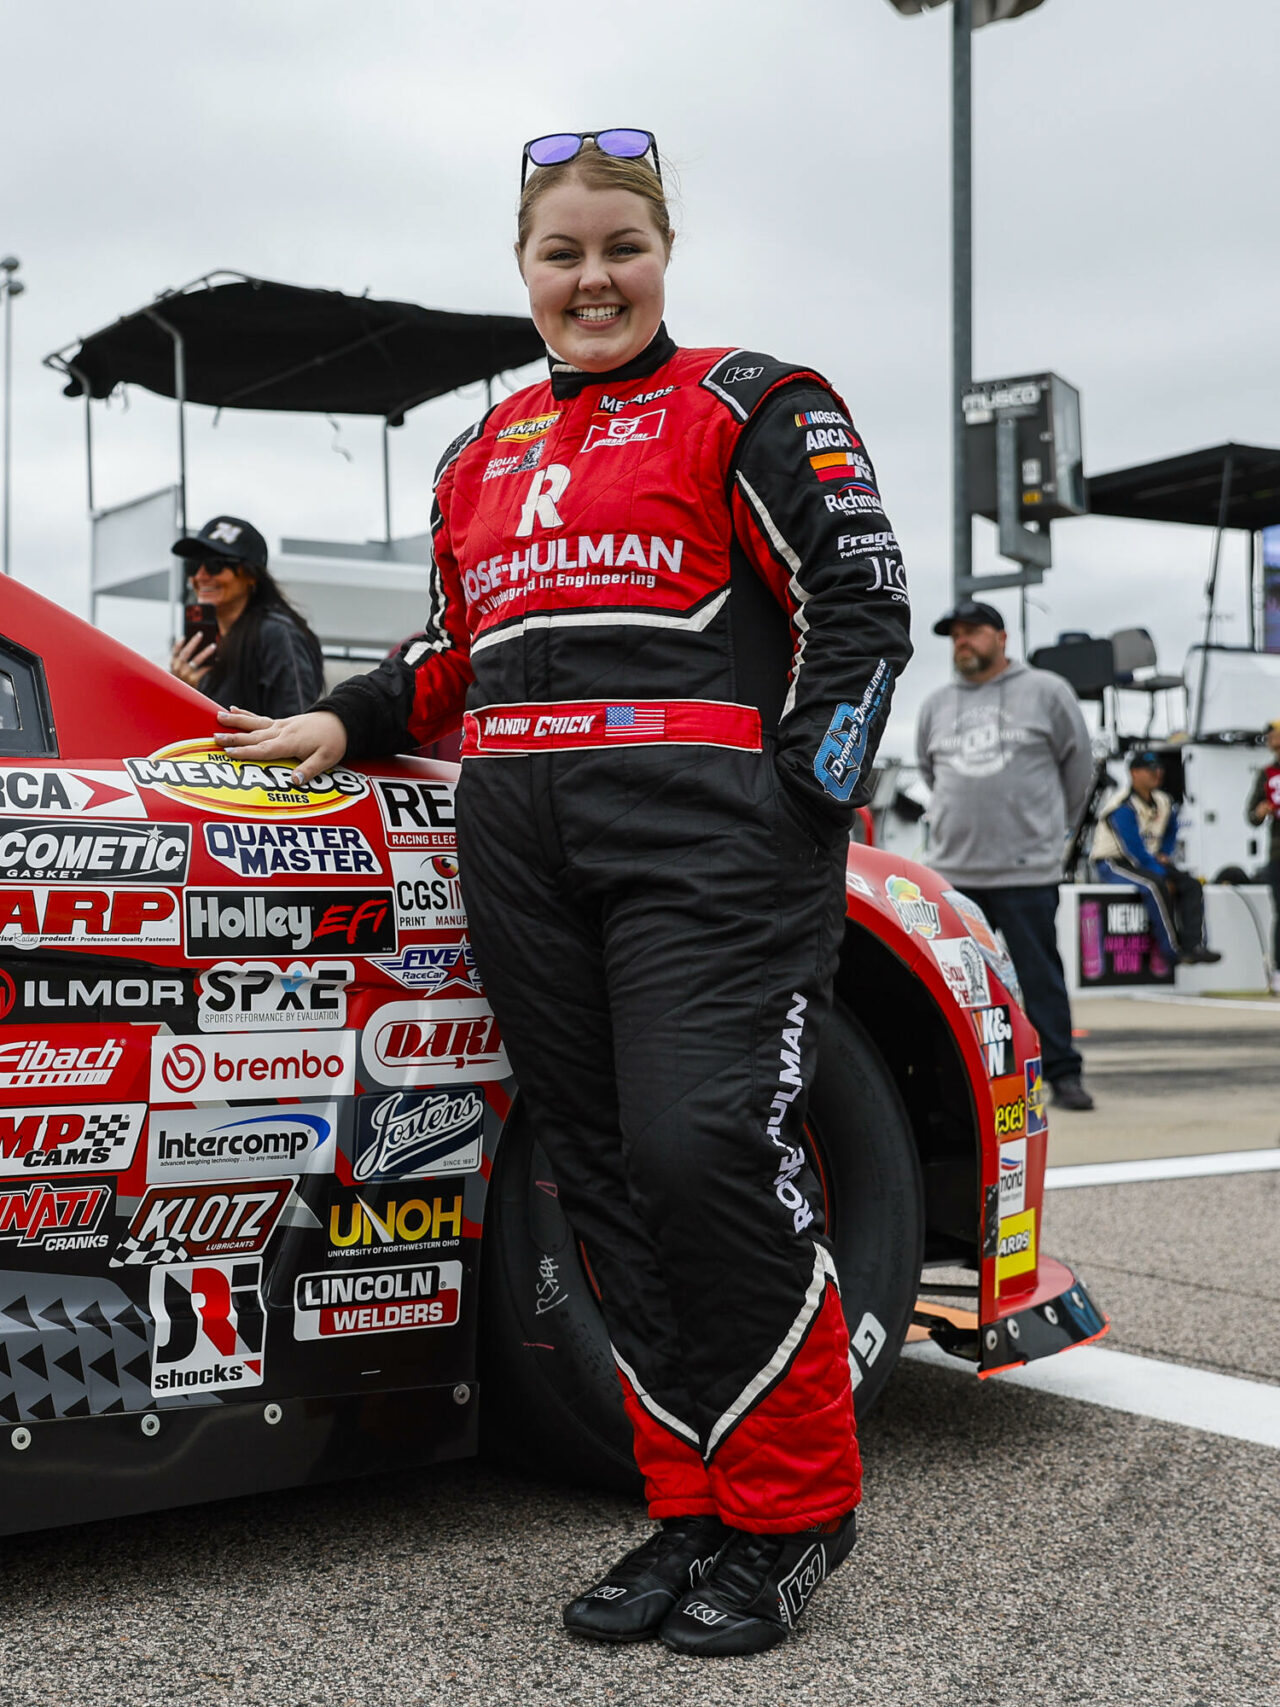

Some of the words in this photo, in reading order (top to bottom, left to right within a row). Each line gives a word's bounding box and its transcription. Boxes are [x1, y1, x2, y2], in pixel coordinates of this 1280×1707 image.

[806, 428, 851, 451] ARCA
[540, 576, 553, 589] in
[556, 572, 656, 589] Engineering
[484, 716, 529, 736] MANDY
[534, 715, 596, 737] CHICK
[267, 793, 310, 804] SERIES
[208, 824, 362, 859] QUARTER
[392, 834, 429, 845] RACING
[241, 848, 377, 875] MASTER
[6, 869, 82, 879] GASKET
[190, 896, 312, 950] Holley
[312, 899, 389, 944] EFI
[400, 916, 426, 926] PRINT
[39, 935, 75, 943] products
[403, 950, 455, 968] FIVE
[402, 971, 445, 980] RaceCar
[24, 979, 184, 1007] ILMOR
[205, 1013, 233, 1023] SPORTS
[286, 1012, 295, 1021] BY
[297, 1010, 339, 1021] EVALUATION
[214, 1048, 344, 1082] brembo
[158, 1129, 309, 1160] Intercomp
[353, 1091, 483, 1180] Jostens
[23, 1147, 111, 1168] CAMS
[160, 1159, 186, 1167] advanced
[187, 1158, 211, 1167] weighing
[212, 1156, 240, 1165] technology
[137, 1191, 280, 1243] KLOTZ
[329, 1193, 463, 1247] UNOH
[46, 1235, 109, 1251] CRANKS
[206, 1240, 255, 1251] LUBRICANTS
[328, 1248, 371, 1258] UNIVERSITY
[373, 1246, 382, 1254] OF
[383, 1241, 441, 1253] NORTHWESTERN
[442, 1239, 460, 1247] OHIO
[303, 1271, 432, 1306] LINCOLN
[333, 1301, 443, 1331] WELDERS
[155, 1364, 243, 1390] shocks
